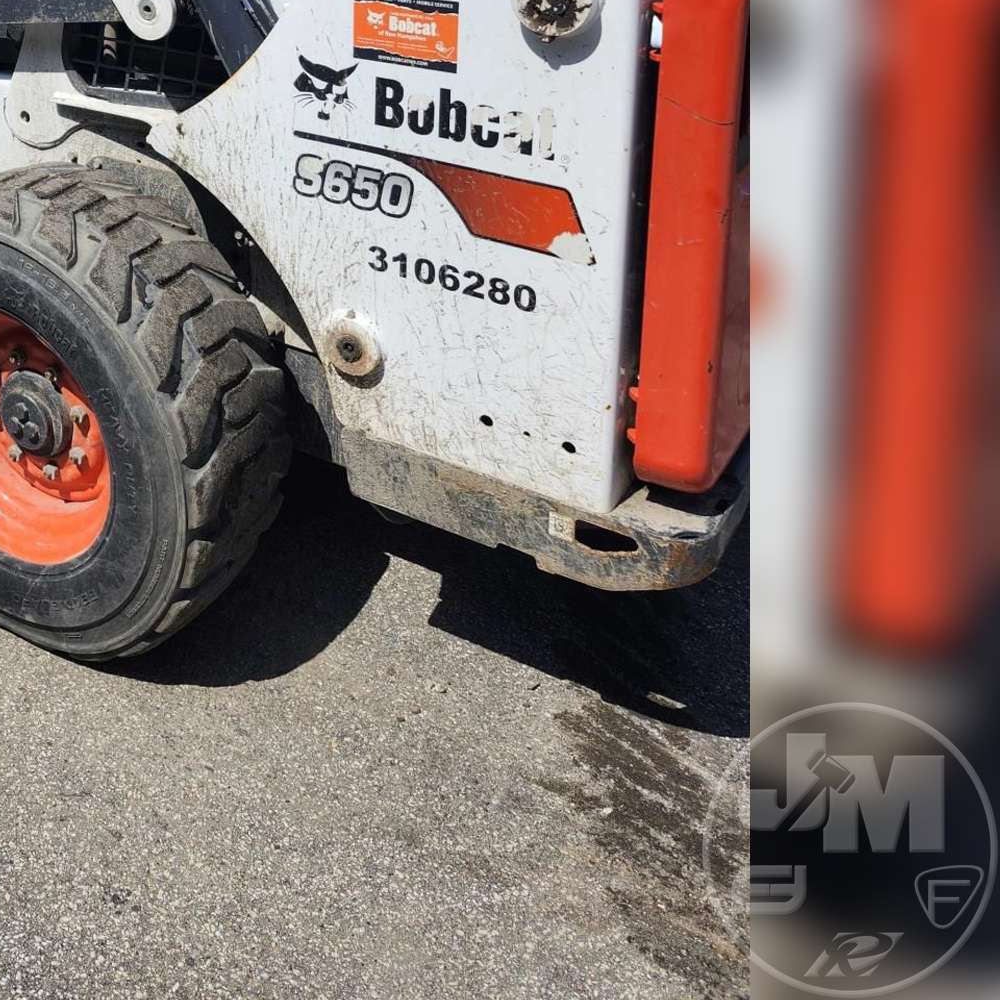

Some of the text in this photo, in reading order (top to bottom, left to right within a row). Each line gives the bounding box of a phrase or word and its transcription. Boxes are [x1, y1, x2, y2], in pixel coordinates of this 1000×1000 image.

[388, 15, 437, 36] Bobcat
[293, 153, 414, 218] S650
[368, 246, 537, 312] 3106280
